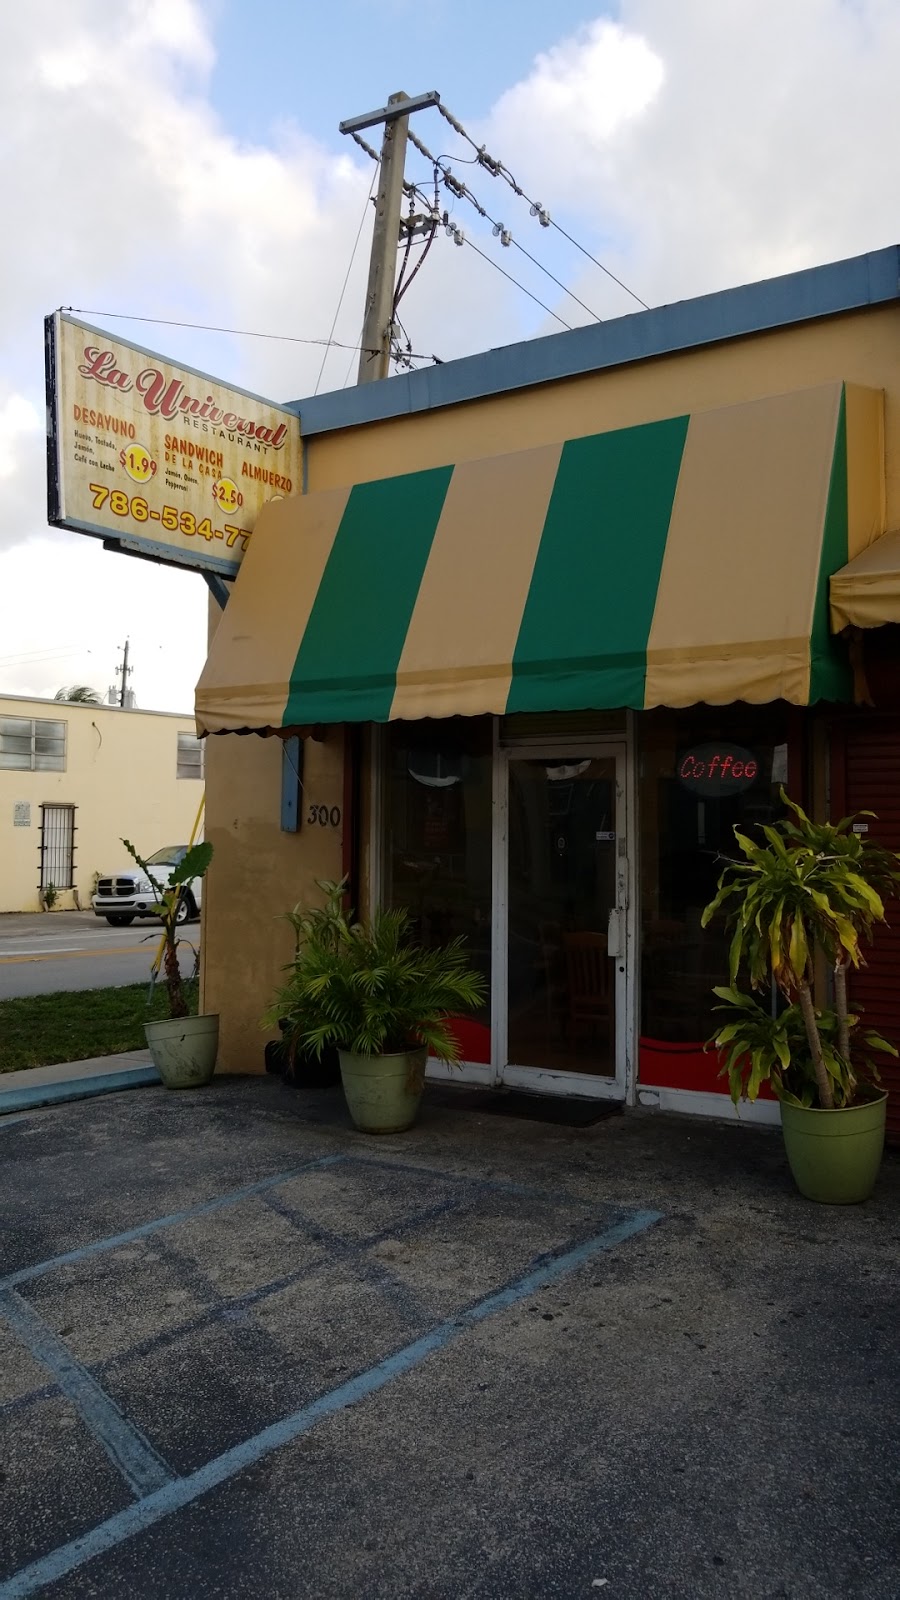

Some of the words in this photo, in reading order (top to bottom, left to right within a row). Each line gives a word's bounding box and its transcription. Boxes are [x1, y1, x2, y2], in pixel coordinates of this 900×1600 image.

[78, 346, 133, 391] La
[136, 369, 287, 449] Universal
[73, 404, 136, 439] DESAYUNO
[184, 417, 268, 454] RESTAURANT
[119, 449, 157, 476] $1.99
[164, 434, 223, 469] SANDWICH
[165, 452, 176, 464] DE
[183, 457, 193, 470] LA
[198, 463, 222, 480] CASA
[241, 461, 293, 492] ALMUERZO
[211, 482, 244, 507] $2.50
[680, 755, 757, 778] Coffee
[307, 804, 341, 827] 300
